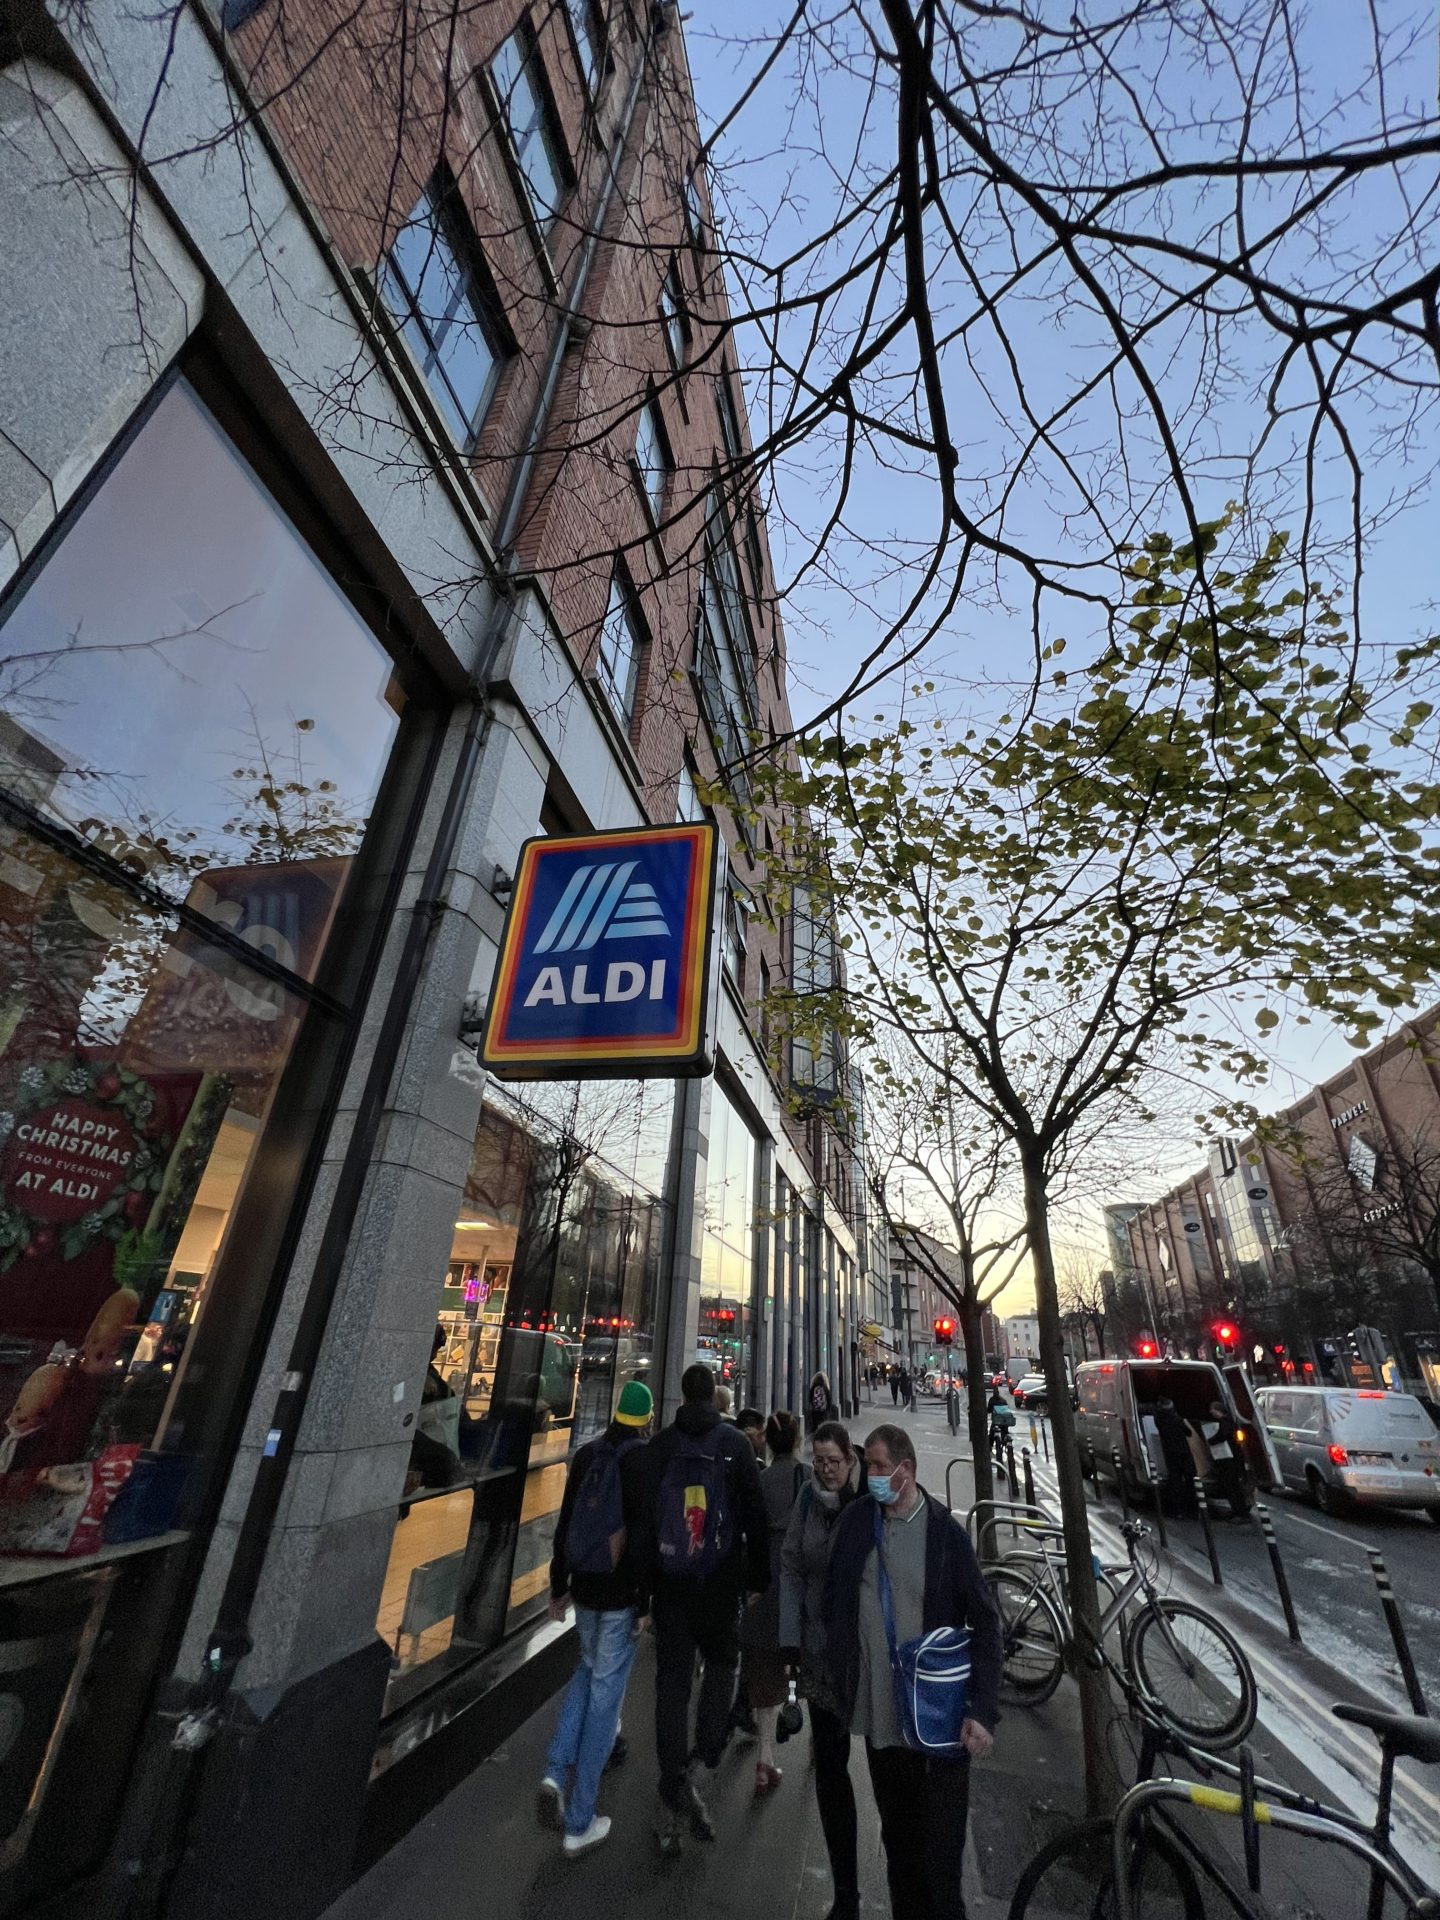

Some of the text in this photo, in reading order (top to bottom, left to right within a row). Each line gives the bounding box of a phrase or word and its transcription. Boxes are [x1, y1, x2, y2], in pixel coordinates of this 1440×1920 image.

[523, 959, 666, 1007] ALDI
[51, 1112, 119, 1141] HAPPY
[17, 1124, 131, 1164] CHRISTMAS
[18, 1151, 112, 1180] FROM EVERYONE
[16, 1171, 98, 1200] AT ALDI
